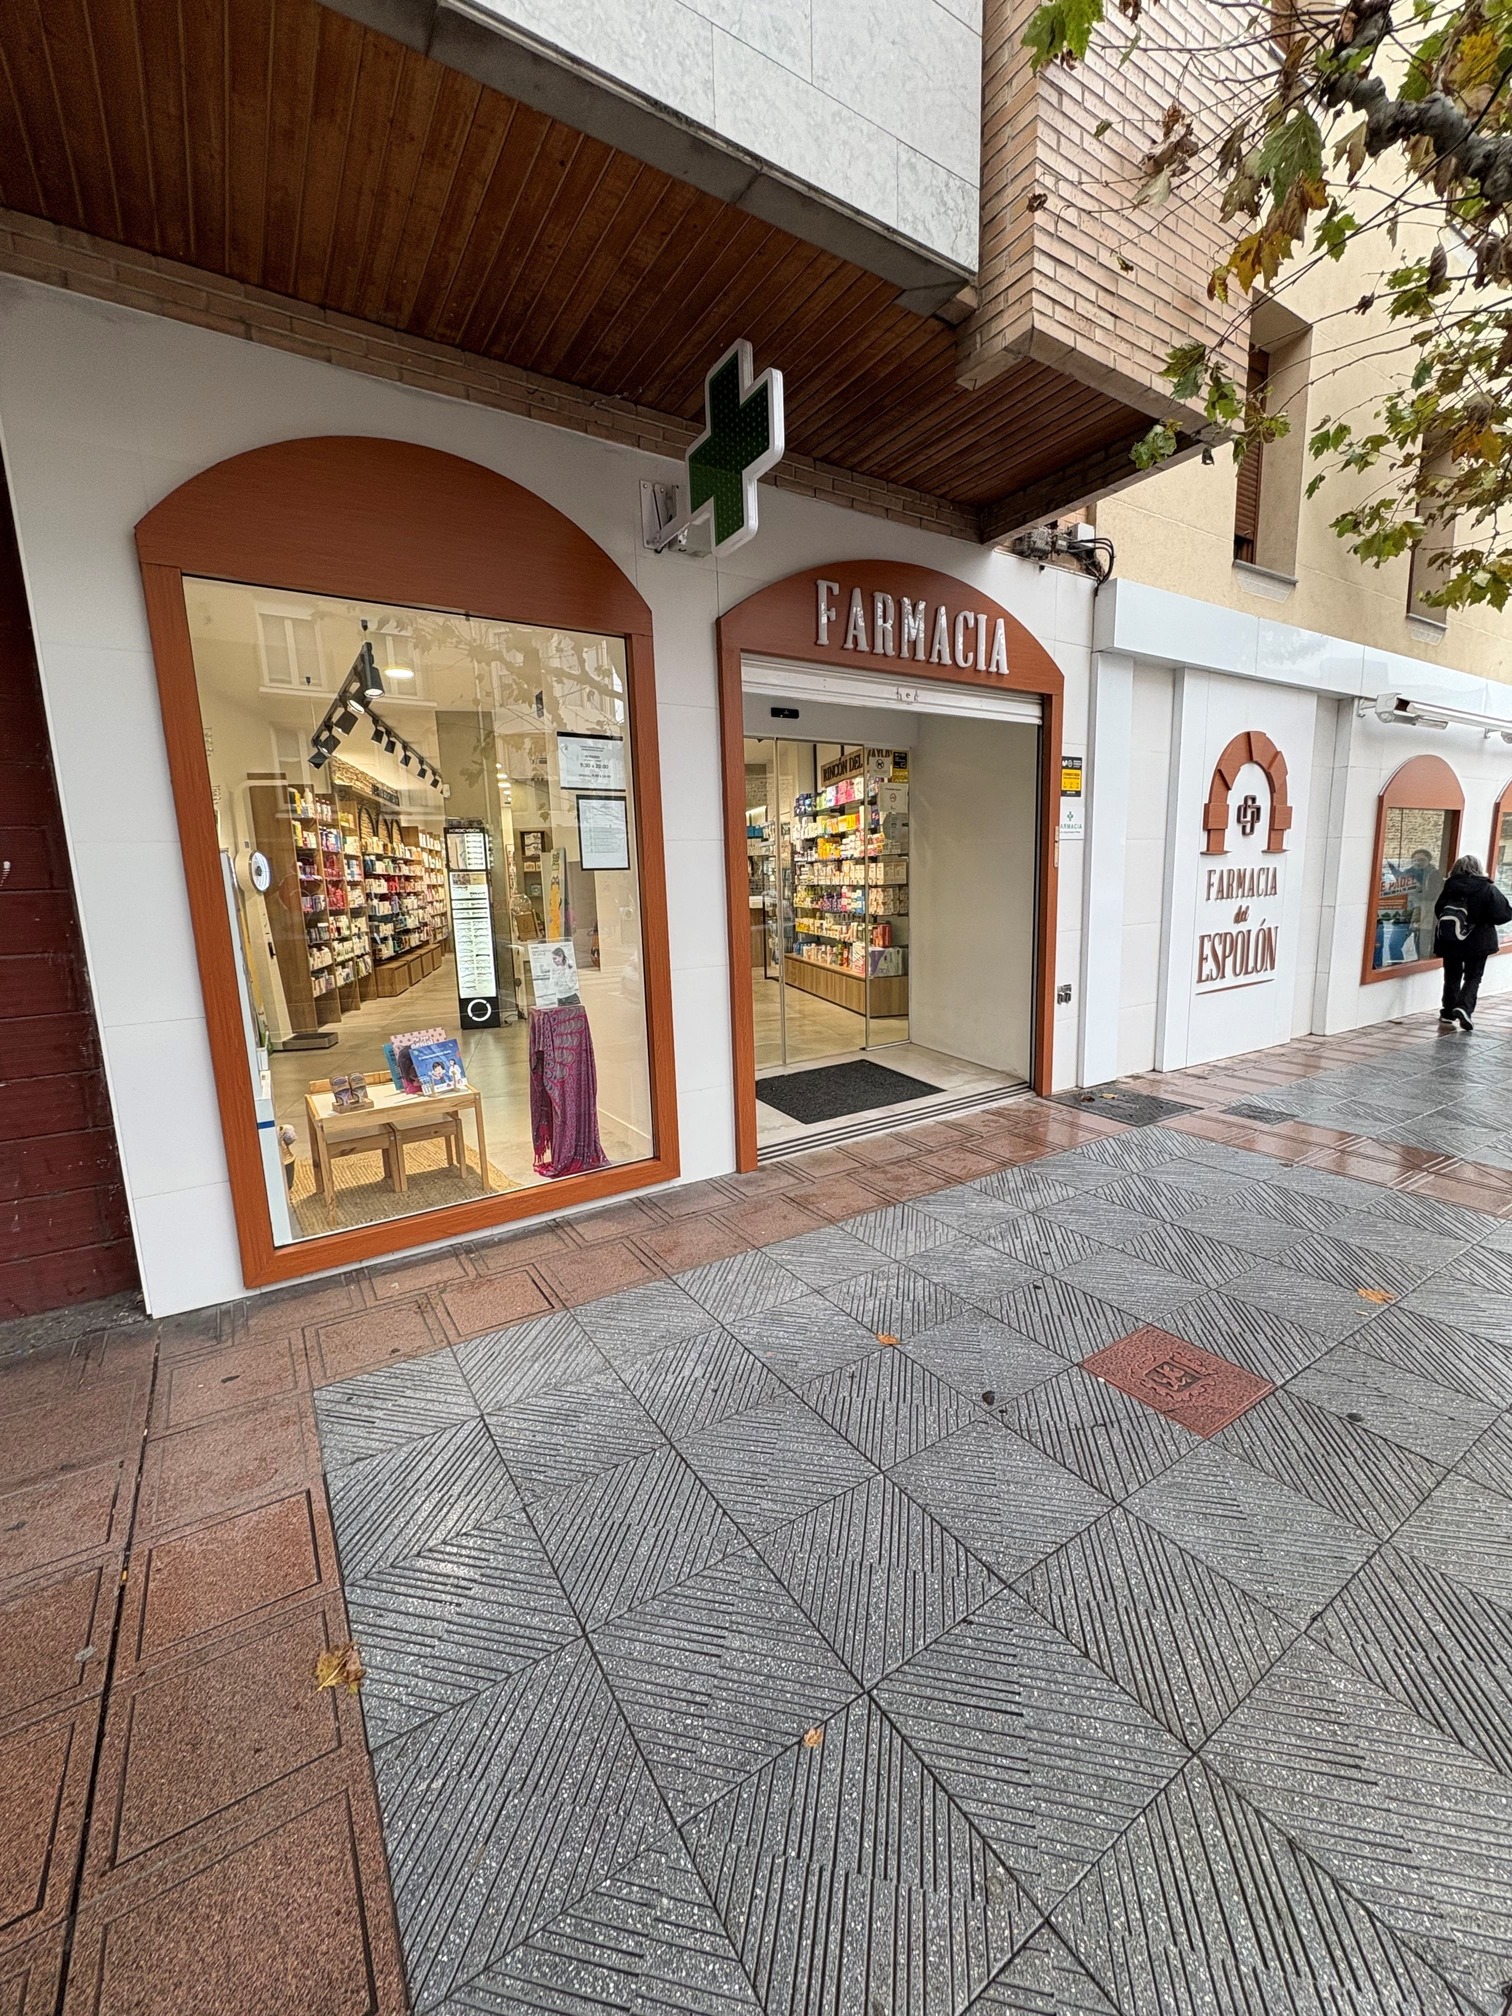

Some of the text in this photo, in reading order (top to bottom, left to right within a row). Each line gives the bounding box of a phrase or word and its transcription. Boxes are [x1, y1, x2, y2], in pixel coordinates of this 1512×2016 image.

[816, 579, 1009, 675] FARMACIA
[849, 754, 862, 772] DEL
[1206, 867, 1278, 900] FARMACIA
[1233, 905, 1249, 924] del
[1196, 918, 1278, 983] ESPOLÓN
